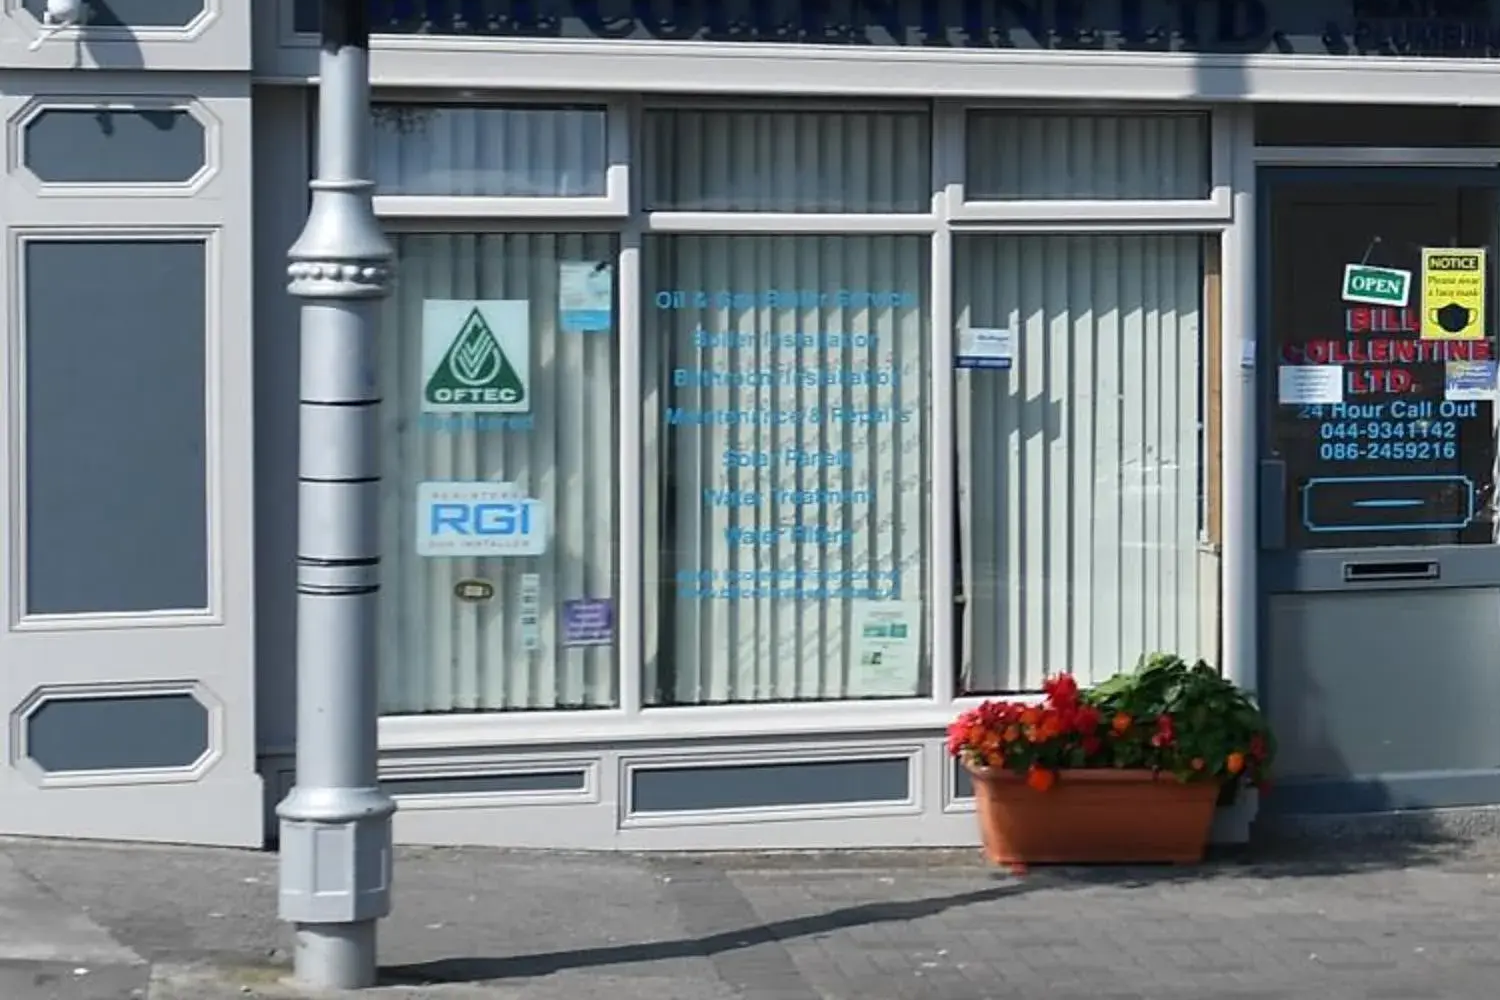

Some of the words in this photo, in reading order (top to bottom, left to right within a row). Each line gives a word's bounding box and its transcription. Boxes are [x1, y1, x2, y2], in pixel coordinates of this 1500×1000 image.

[1430, 256, 1478, 269] NOTICE
[1351, 275, 1401, 294] OPEN
[656, 291, 685, 308] Oil
[1346, 306, 1421, 334] BILL
[1283, 337, 1493, 364] COLLENTINE
[1347, 367, 1422, 394] LTD.
[435, 388, 517, 402] OFTEC
[1331, 402, 1383, 419] Hour
[1390, 400, 1431, 418] Call
[1439, 400, 1477, 418] Out
[1320, 442, 1456, 460] 086-2459216
[430, 503, 530, 536] RGI
